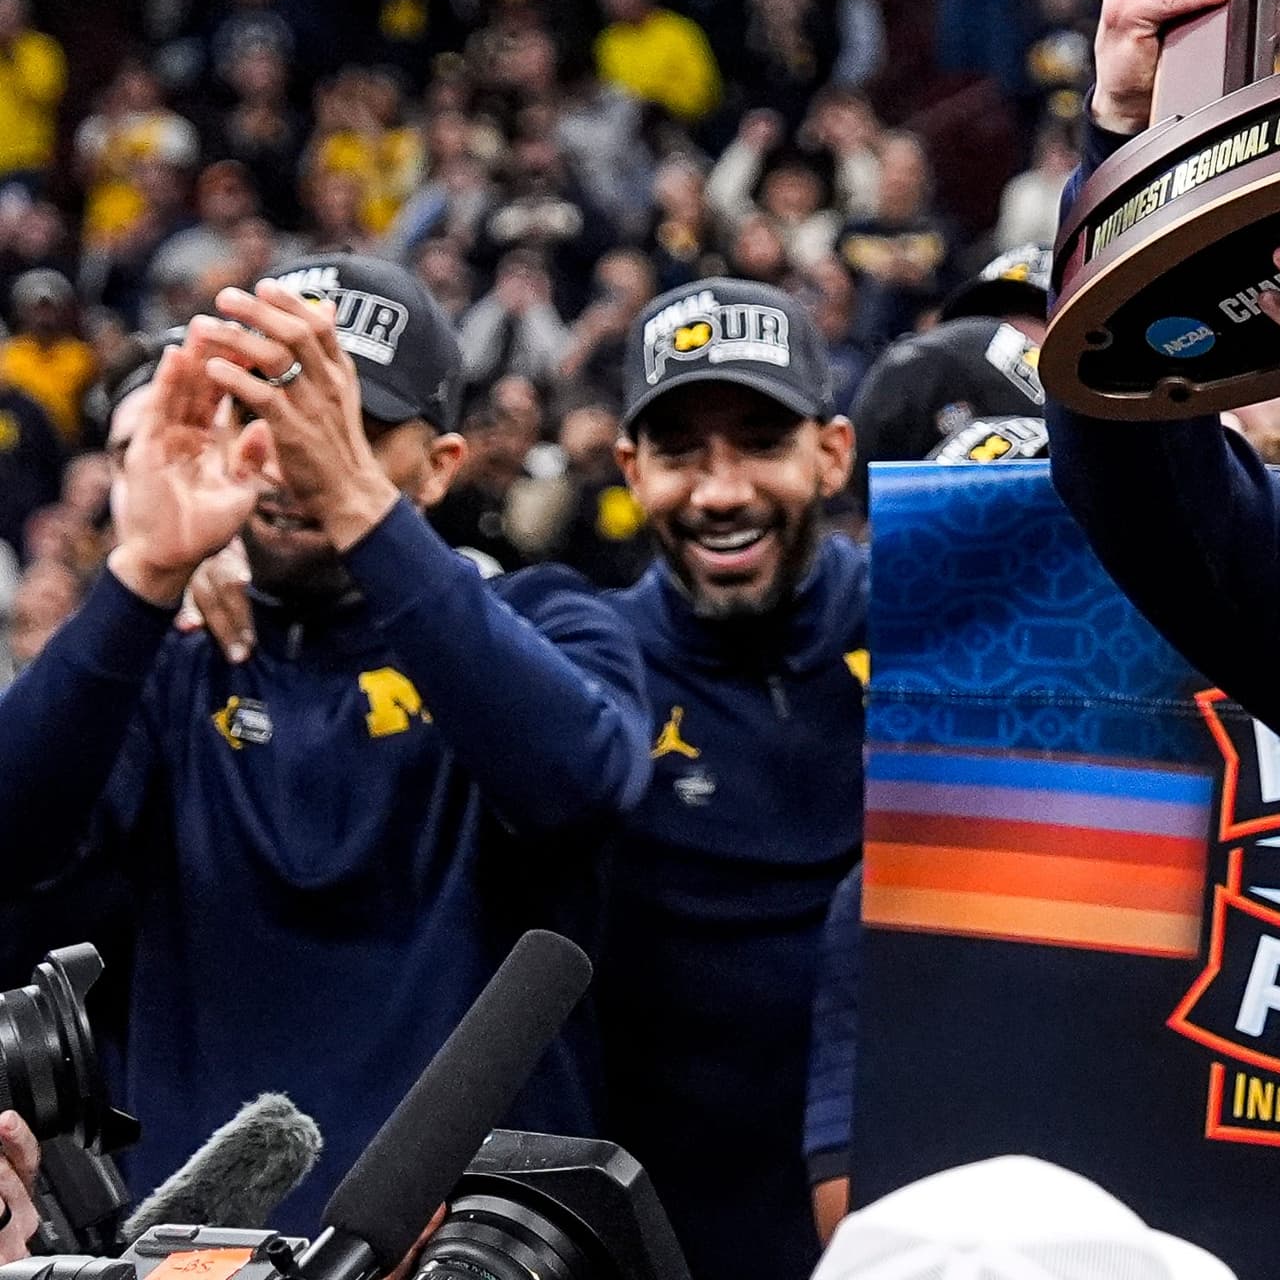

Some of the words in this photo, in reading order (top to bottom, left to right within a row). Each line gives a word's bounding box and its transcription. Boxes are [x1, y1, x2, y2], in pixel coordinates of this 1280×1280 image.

[1092, 171, 1173, 261] MIDWEST
[1171, 121, 1270, 199] REGIONAL
[1162, 326, 1214, 355] NCAA
